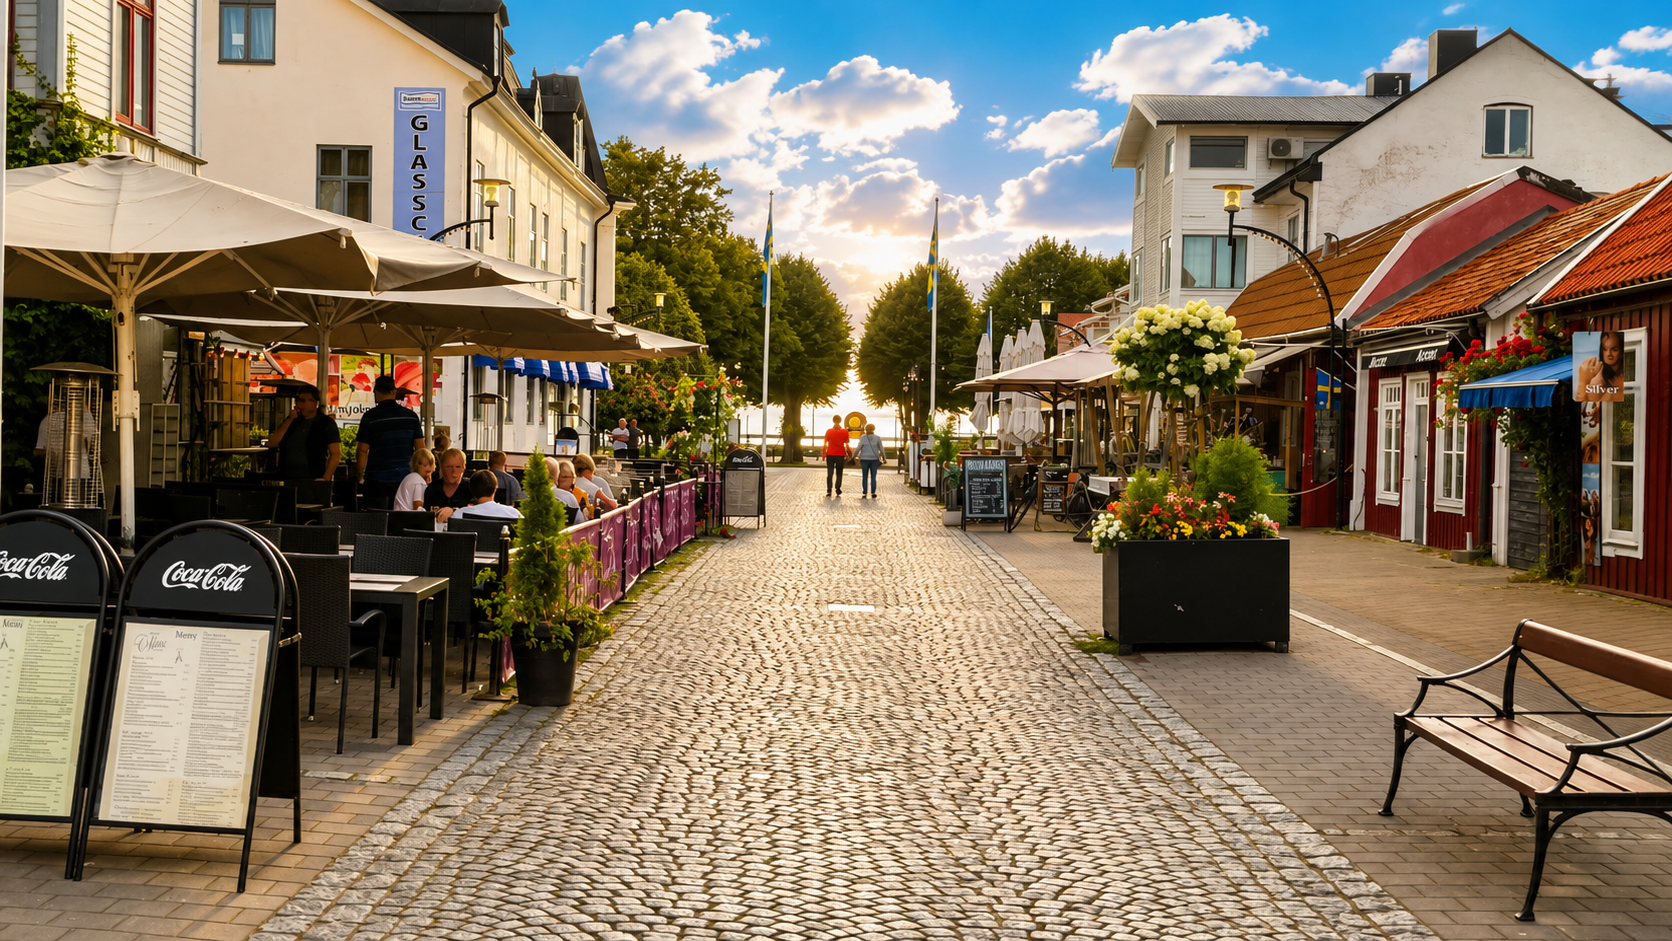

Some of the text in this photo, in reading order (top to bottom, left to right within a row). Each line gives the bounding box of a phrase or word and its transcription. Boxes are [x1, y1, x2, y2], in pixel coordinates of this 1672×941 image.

[410, 114, 429, 239] GLASSC
[1585, 384, 1619, 394] Silver
[161, 560, 252, 592] Coca-Cola
